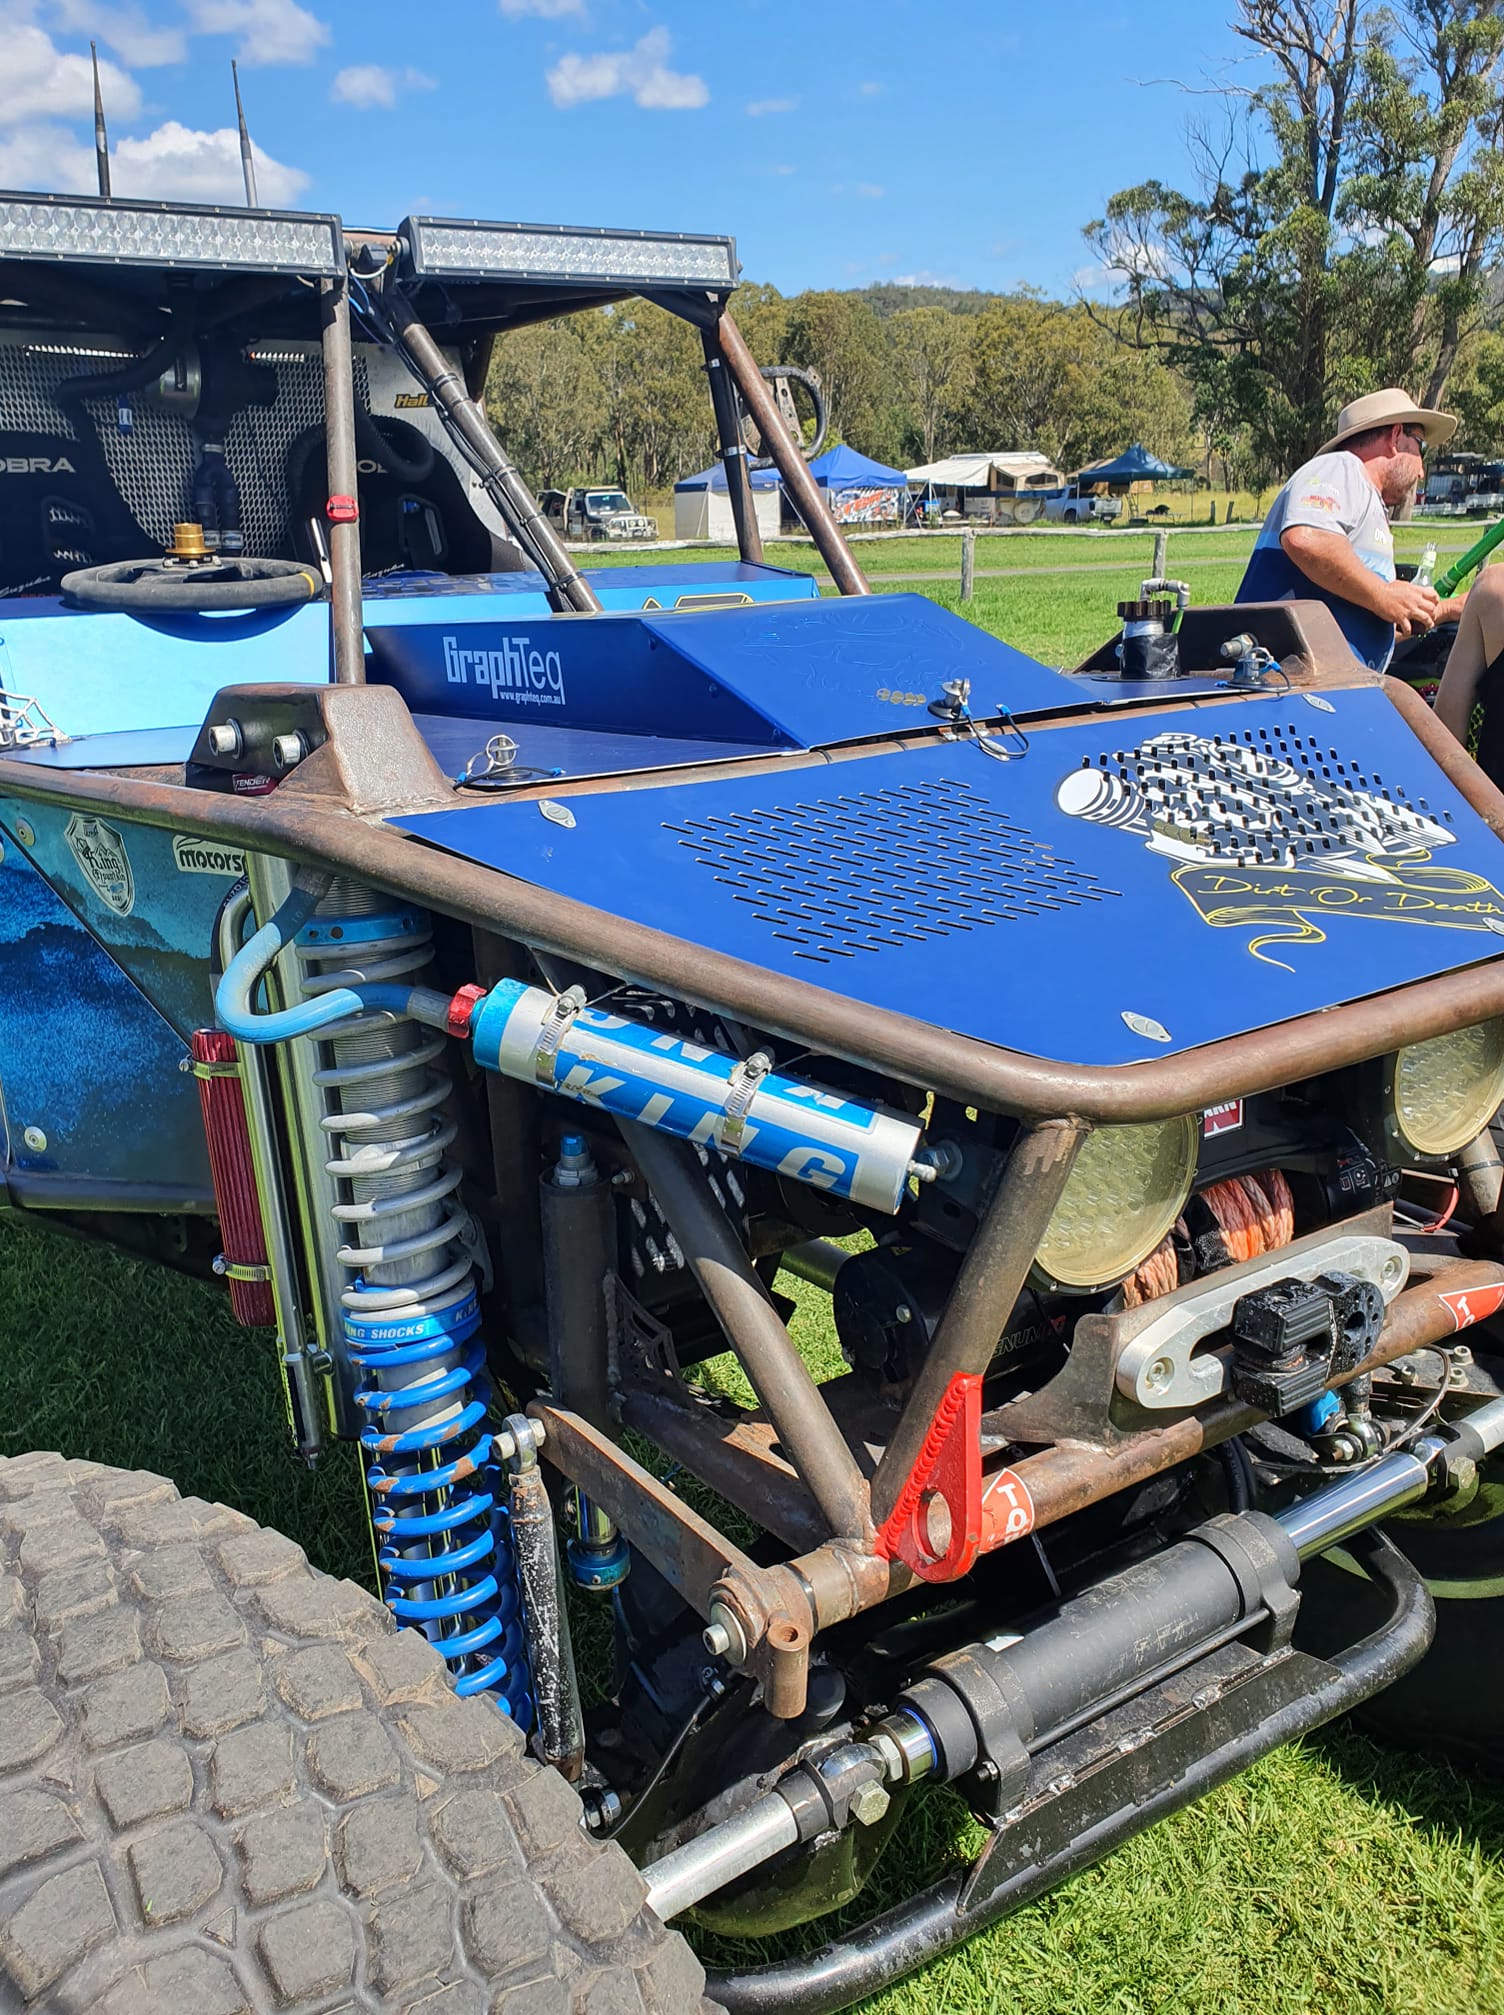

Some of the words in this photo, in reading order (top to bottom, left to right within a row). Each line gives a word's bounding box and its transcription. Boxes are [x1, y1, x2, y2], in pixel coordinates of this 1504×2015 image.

[442, 636, 566, 705] GraphTeq
[499, 690, 562, 706] www.graphteq.com.au
[1198, 875, 1306, 898] Dirt
[1309, 886, 1374, 905] Or
[1383, 892, 1504, 914] Death
[556, 1064, 847, 1190] KING
[371, 1323, 425, 1340] SHOCKS
